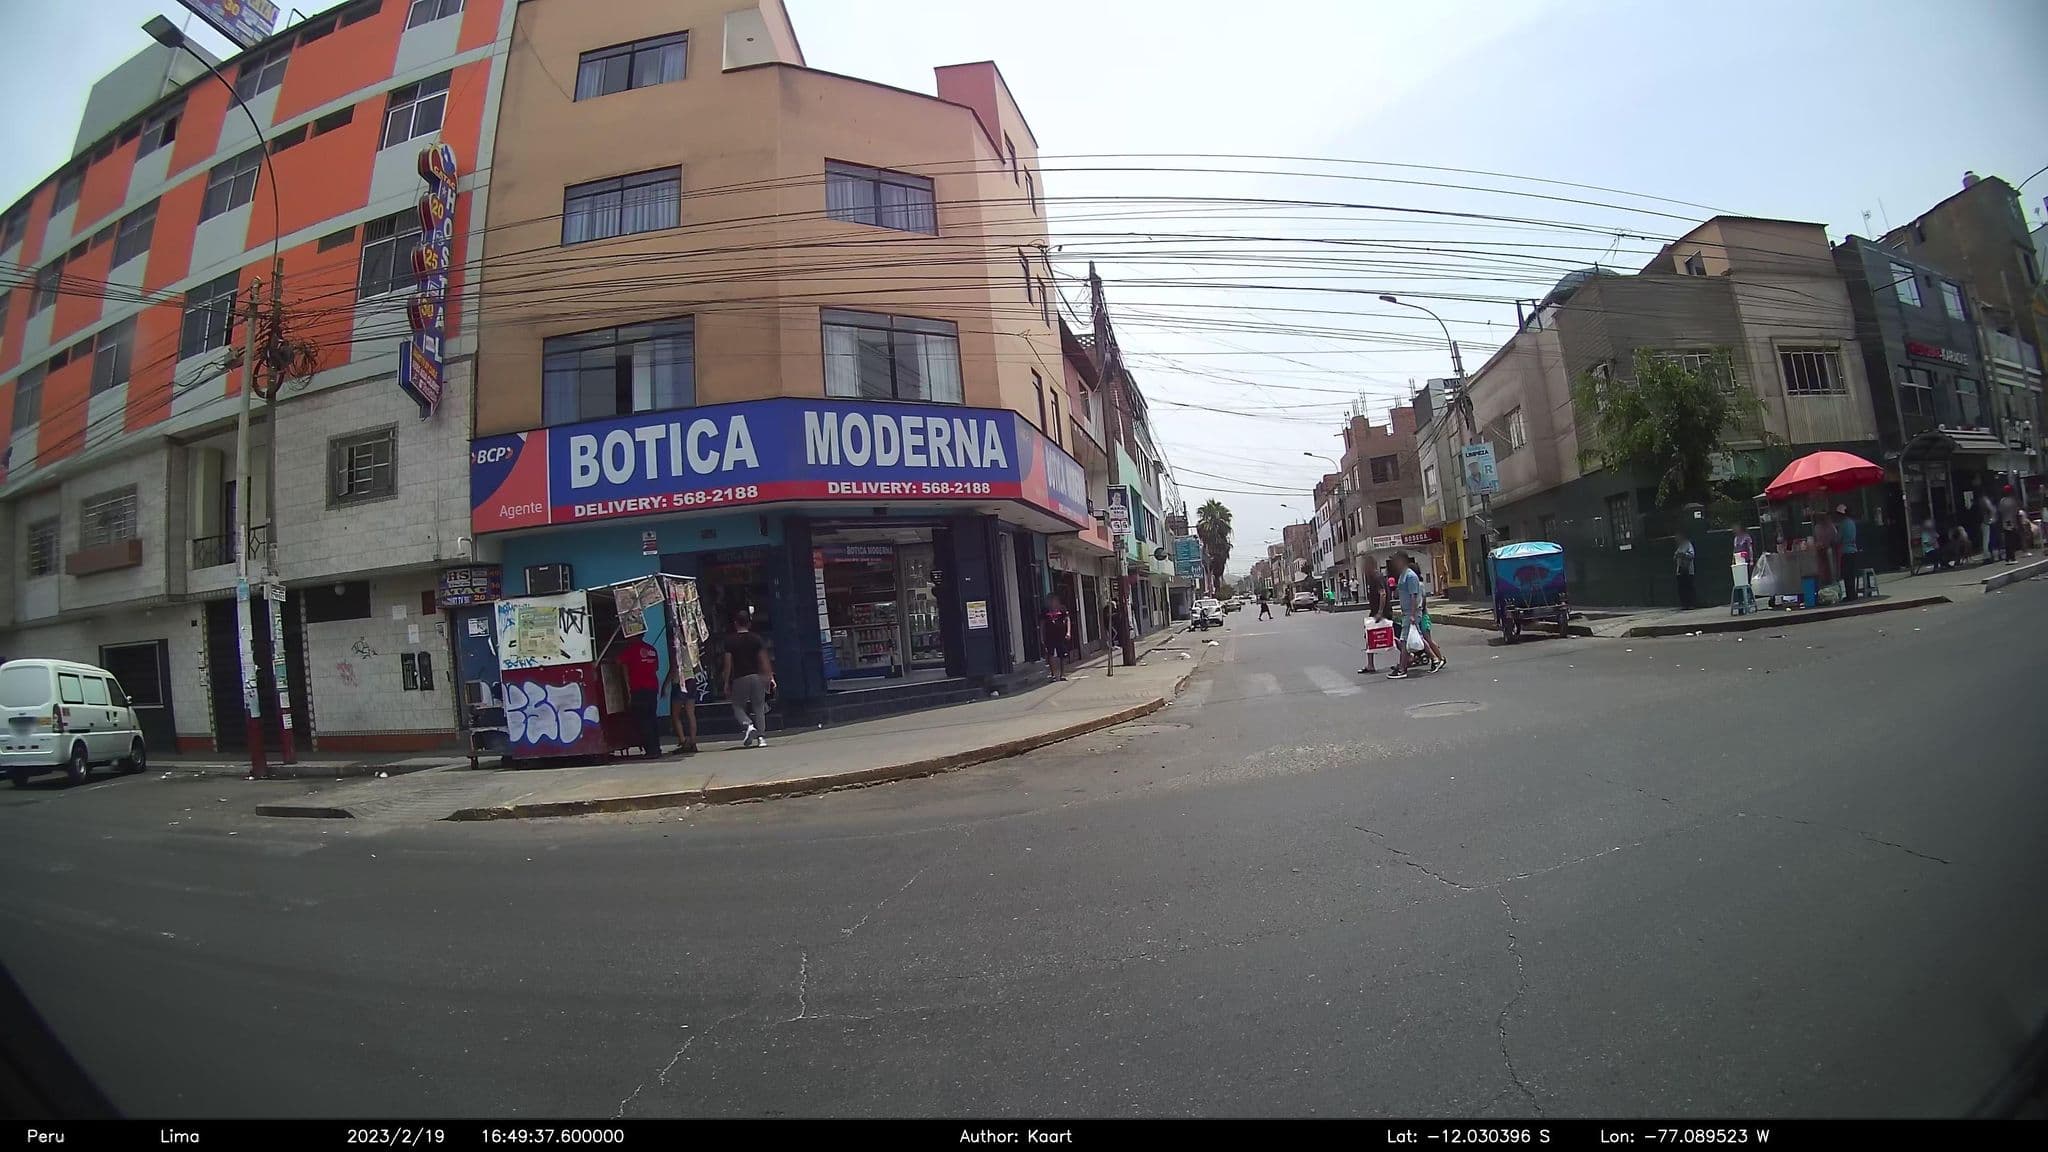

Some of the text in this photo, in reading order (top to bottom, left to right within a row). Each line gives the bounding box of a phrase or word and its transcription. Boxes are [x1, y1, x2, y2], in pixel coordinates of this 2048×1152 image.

[431, 198, 444, 219] 20
[424, 248, 438, 270] 25
[435, 188, 456, 363] HOSTAL
[477, 447, 505, 464] BCP
[570, 410, 1008, 489] BOTICA MODERNA
[828, 481, 991, 495] DELIVERY: 568-2188
[499, 501, 544, 520] Agente
[574, 485, 760, 518] DELIVERY: 568-2188
